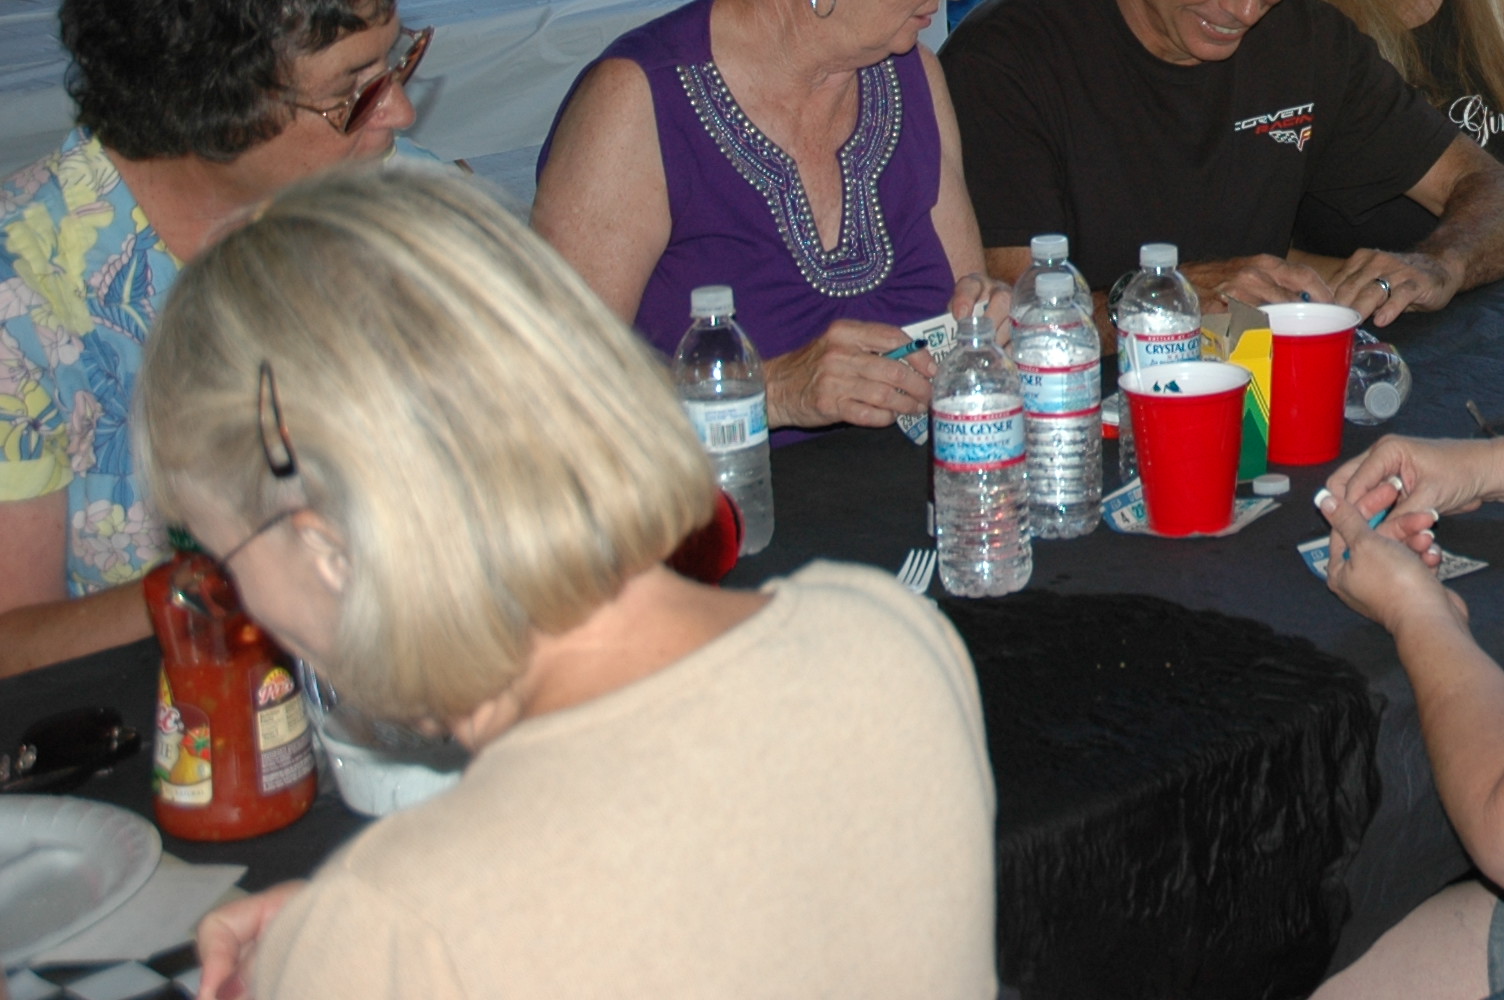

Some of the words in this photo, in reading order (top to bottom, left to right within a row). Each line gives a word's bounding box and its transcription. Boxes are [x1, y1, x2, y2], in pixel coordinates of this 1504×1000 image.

[1233, 101, 1316, 133] ORVETT
[1254, 113, 1315, 136] RACIN
[1145, 342, 1185, 355] CRYSTAL
[970, 419, 1013, 435] GEYSER
